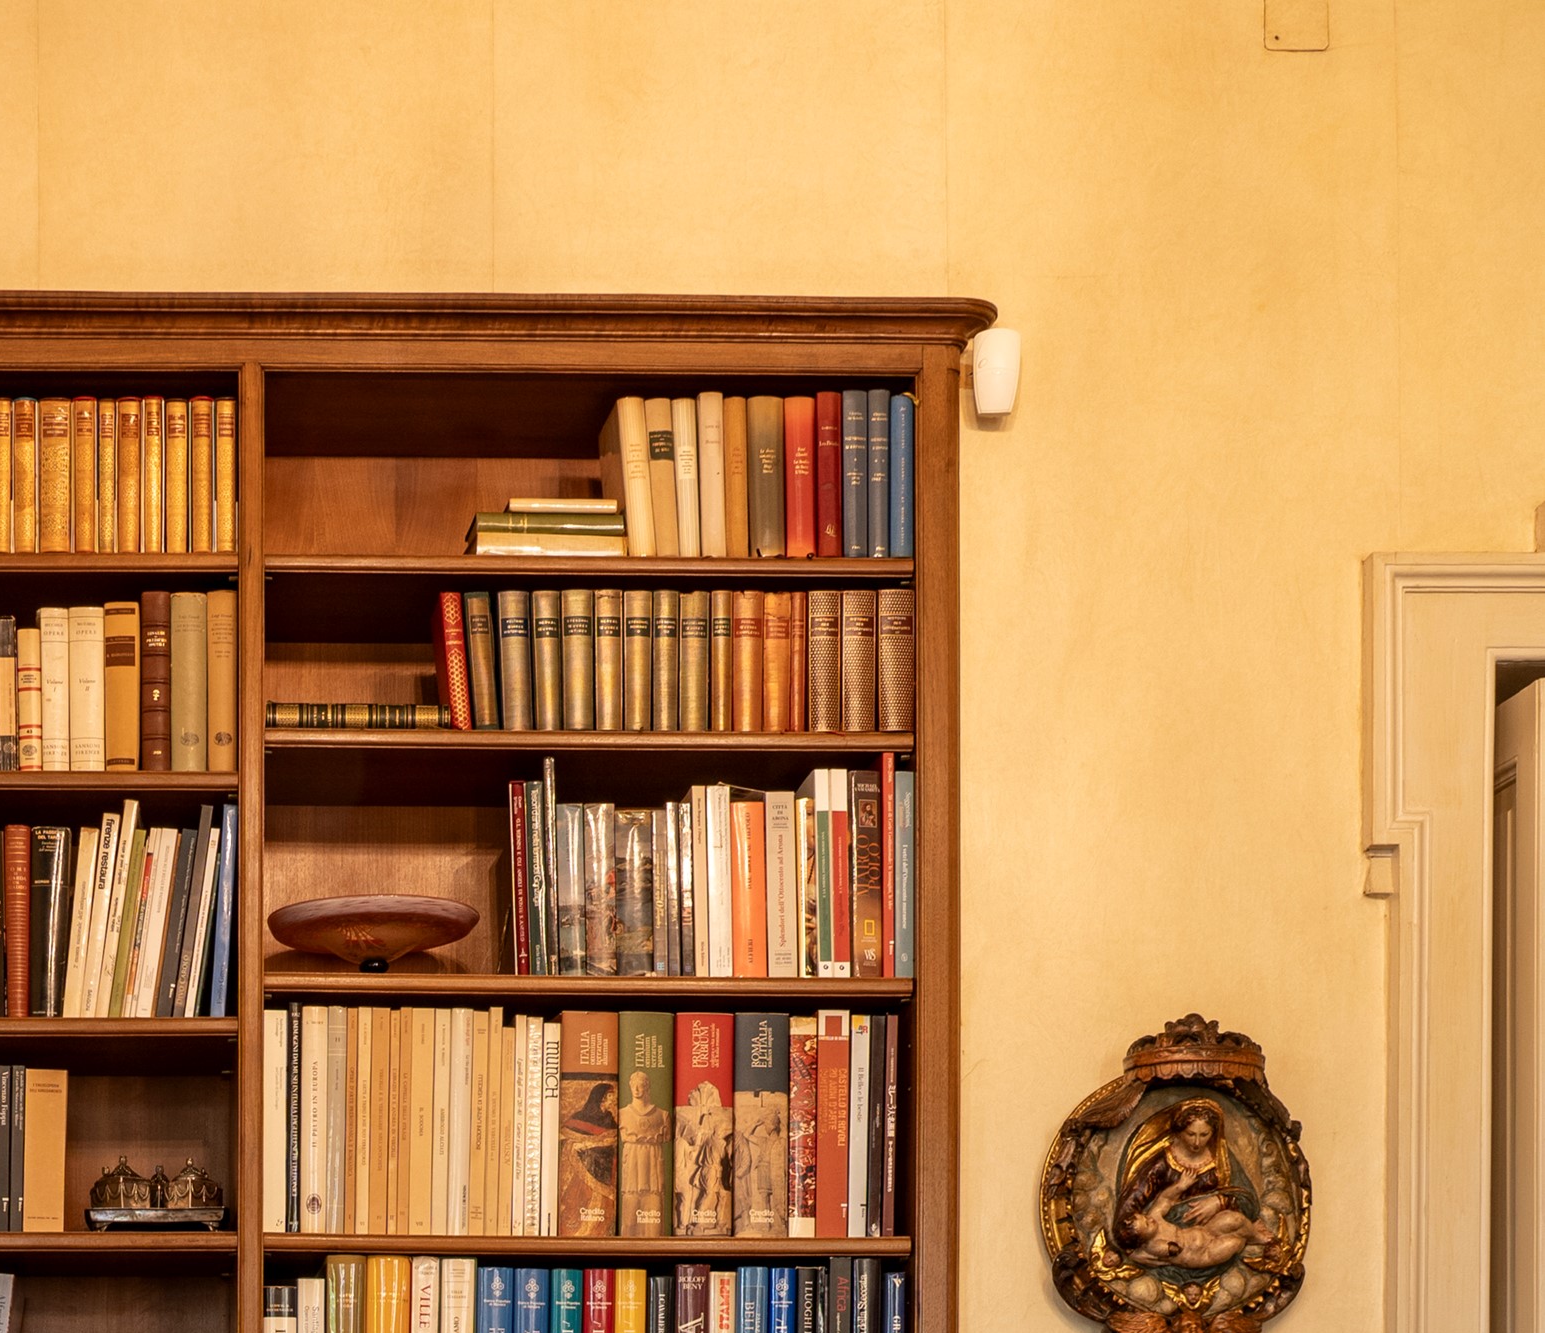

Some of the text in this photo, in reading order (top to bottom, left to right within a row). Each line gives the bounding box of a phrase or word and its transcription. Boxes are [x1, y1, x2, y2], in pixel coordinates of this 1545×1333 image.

[98, 818, 114, 889] firenze restaura
[778, 856, 783, 865] ad
[857, 834, 869, 895] MARCO
[869, 842, 881, 889] POLO
[777, 866, 785, 913] dell'Ottocento
[580, 1031, 589, 1065] ITALIA
[635, 1033, 645, 1067] ITALIA
[692, 1020, 701, 1068] PRINCEPS
[752, 1037, 760, 1067] ROMA
[580, 1207, 605, 1215] Credito
[749, 1209, 774, 1217] Credito
[720, 1279, 730, 1332] STAMPE
[804, 1287, 812, 1329] LUOGHI
[836, 1276, 849, 1312] Africa
